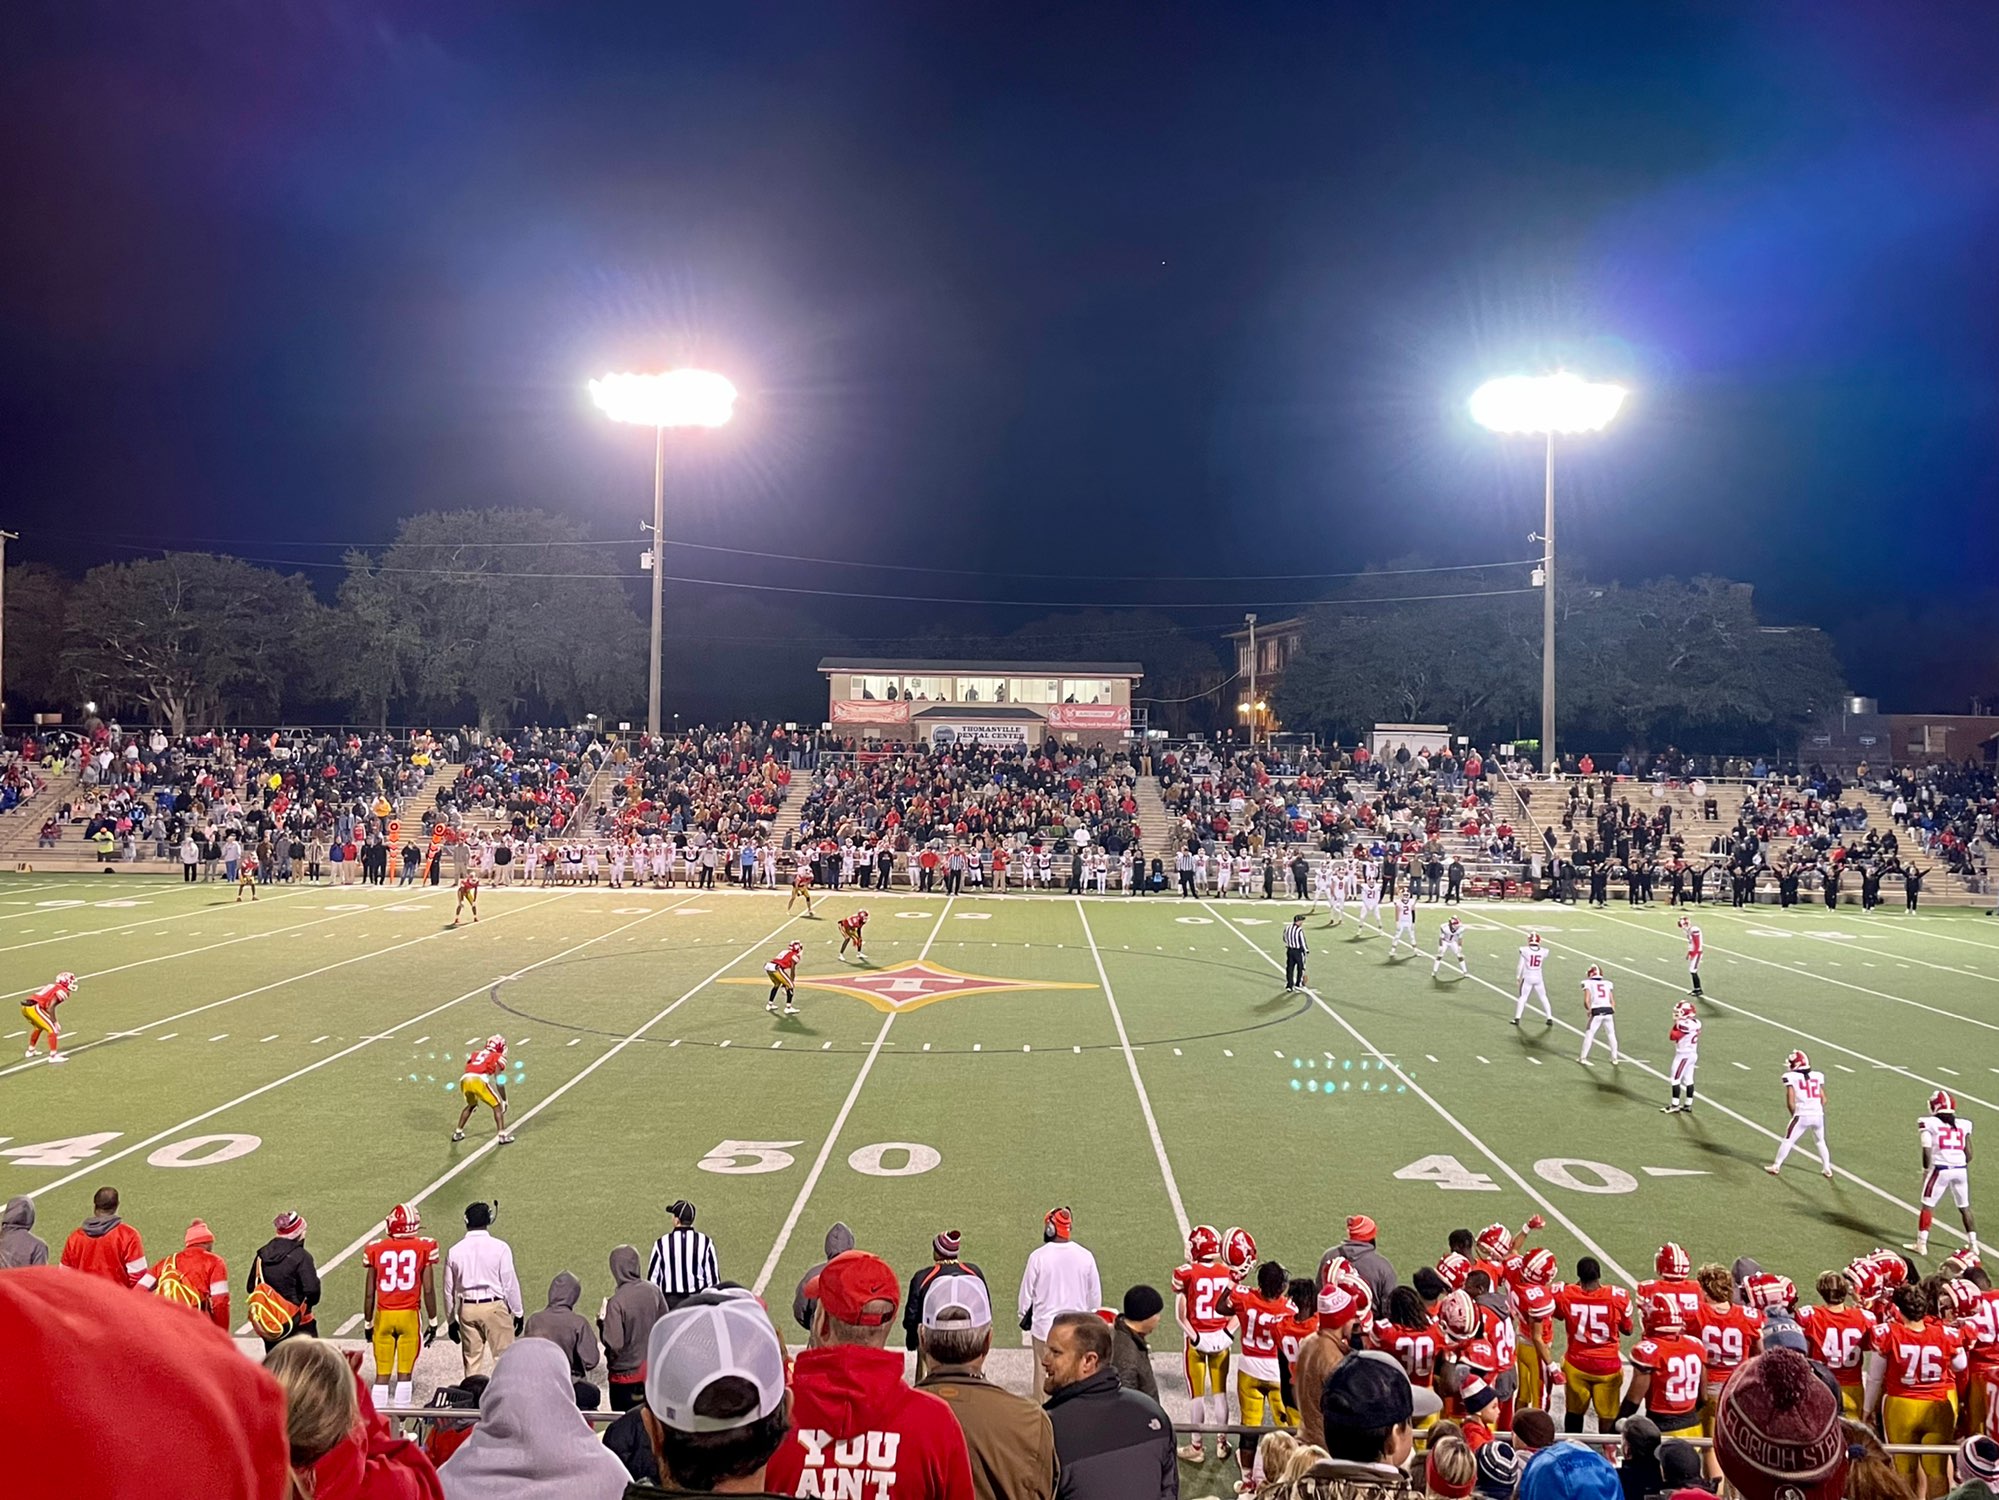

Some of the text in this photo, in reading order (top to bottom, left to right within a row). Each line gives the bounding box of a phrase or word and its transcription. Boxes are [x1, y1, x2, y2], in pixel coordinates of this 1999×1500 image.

[1366, 890, 1376, 899] 21
[1402, 905, 1409, 915] 2
[1529, 954, 1541, 968] 16
[1597, 984, 1606, 999] 5
[1798, 1078, 1821, 1099] 42
[1937, 1126, 1965, 1151] 23
[379, 1249, 418, 1292] 33
[1243, 1307, 1277, 1351] 13
[1570, 1303, 1610, 1345] 75
[1395, 1335, 1435, 1377] 30
[1702, 1324, 1743, 1367] 69
[1820, 1326, 1865, 1369] 46
[1899, 1343, 1943, 1386] 76
[1665, 1353, 1702, 1402] 28
[797, 1428, 901, 1470] YOU
[1725, 1408, 1797, 1470] FLORIDA
[794, 1467, 897, 1500] AIN'T
